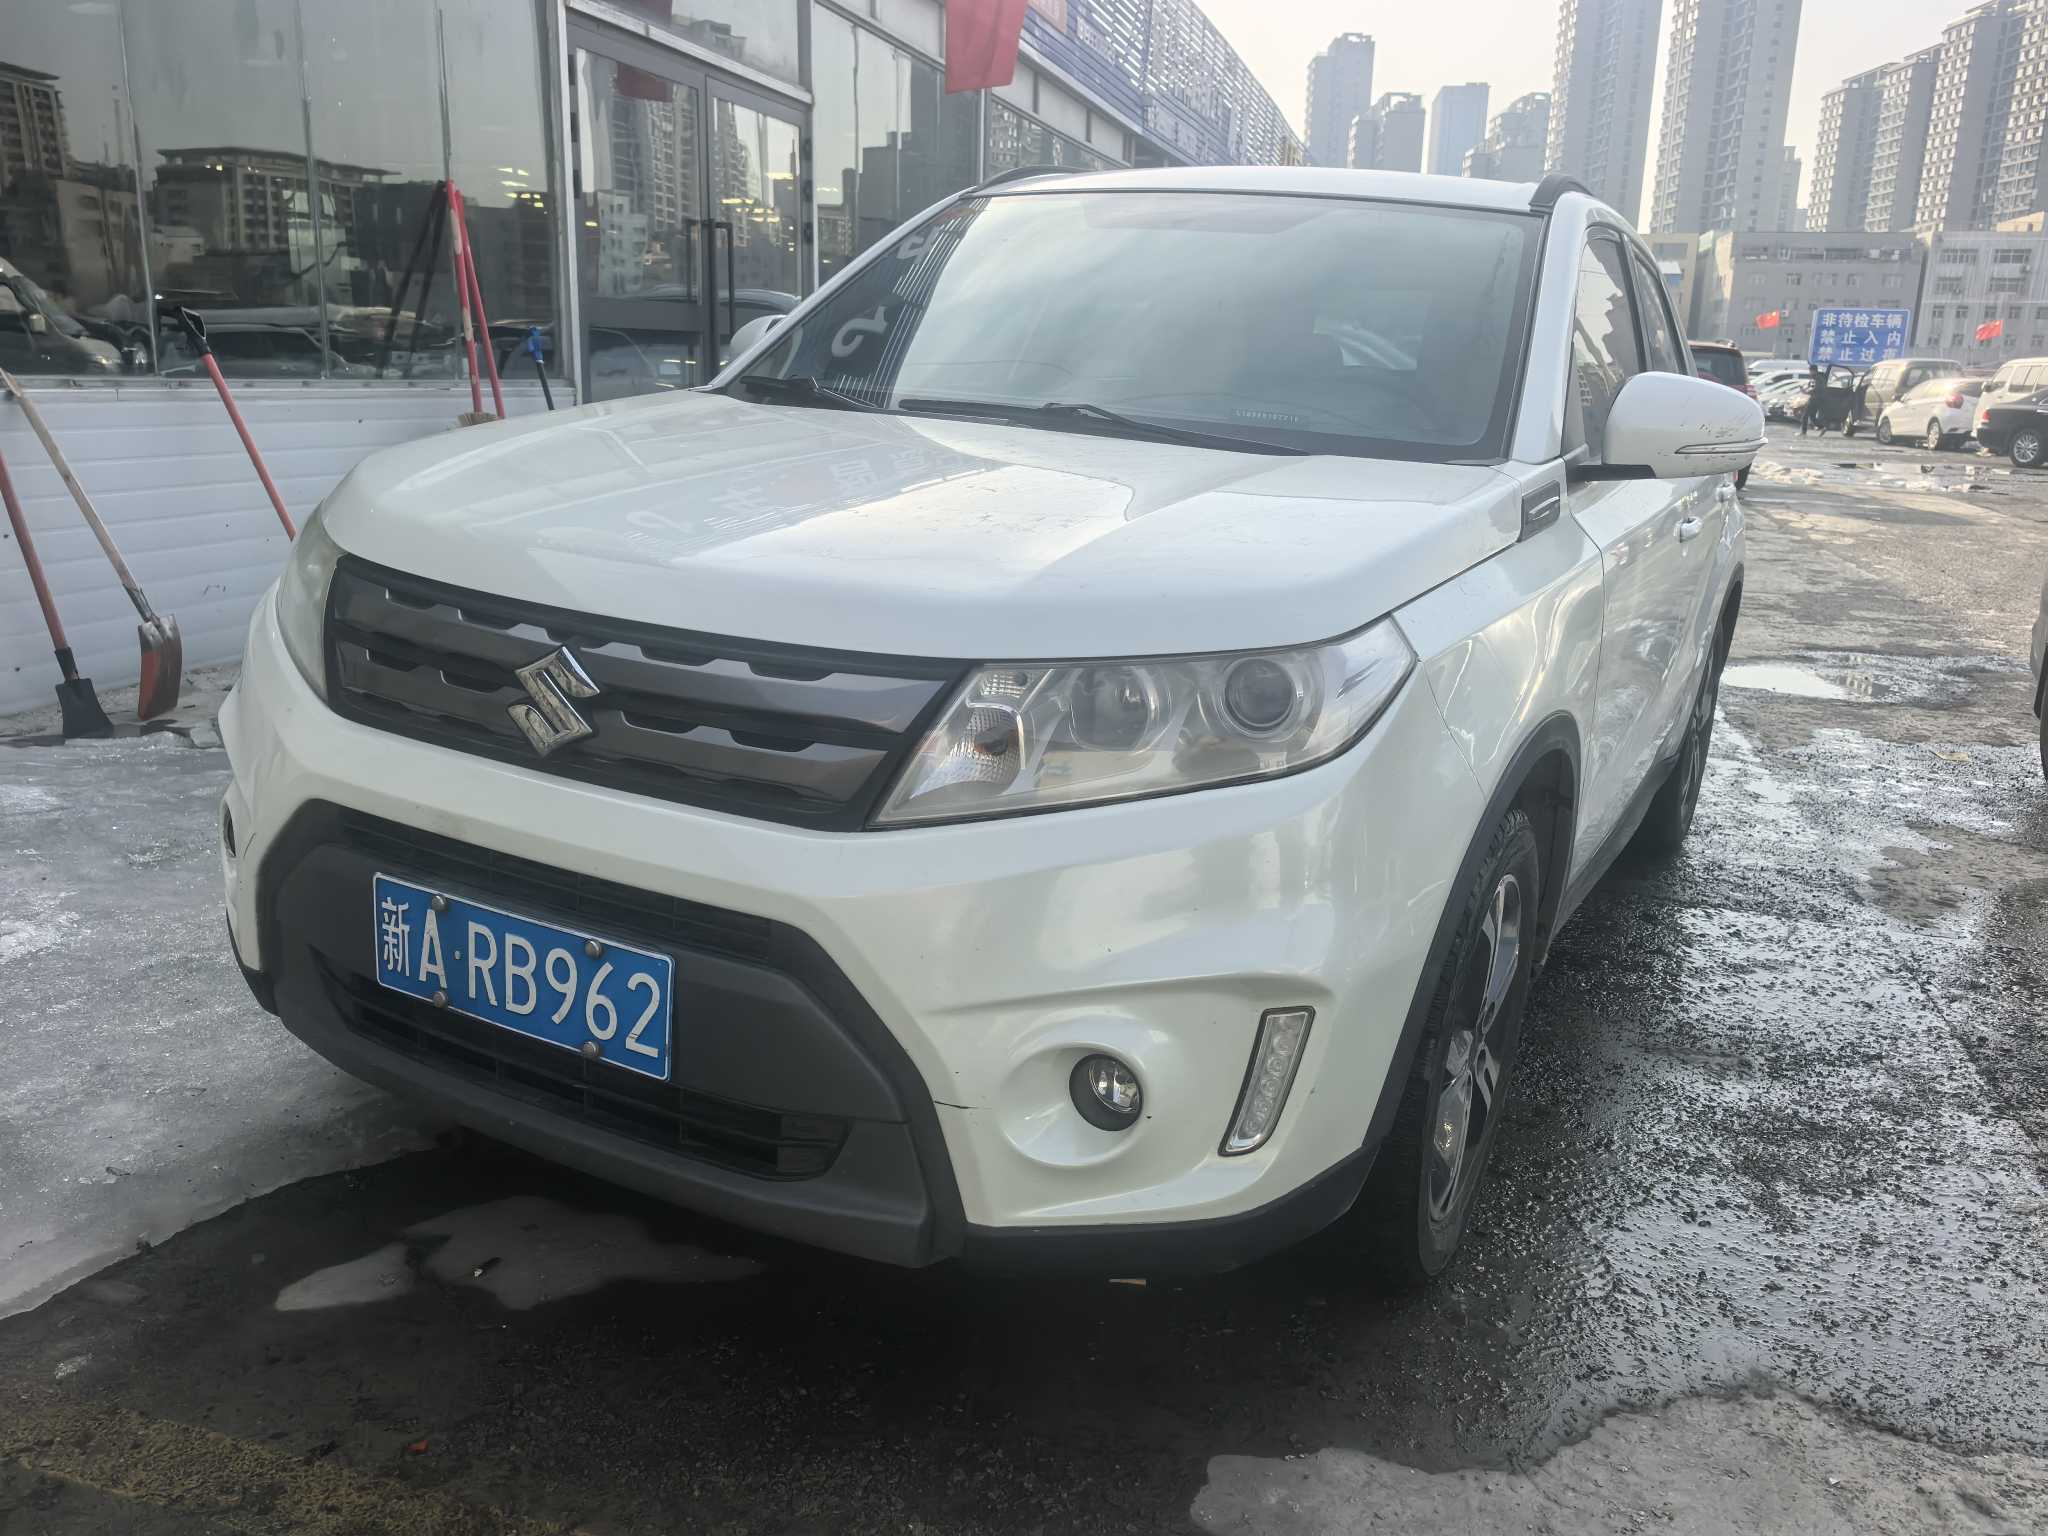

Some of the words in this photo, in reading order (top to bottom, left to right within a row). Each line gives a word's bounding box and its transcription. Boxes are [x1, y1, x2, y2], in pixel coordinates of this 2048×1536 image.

[1823, 312, 1903, 328] 非待检车辆
[1820, 330, 1900, 346] 禁止入内
[381, 897, 660, 1058] 新A·RB962
